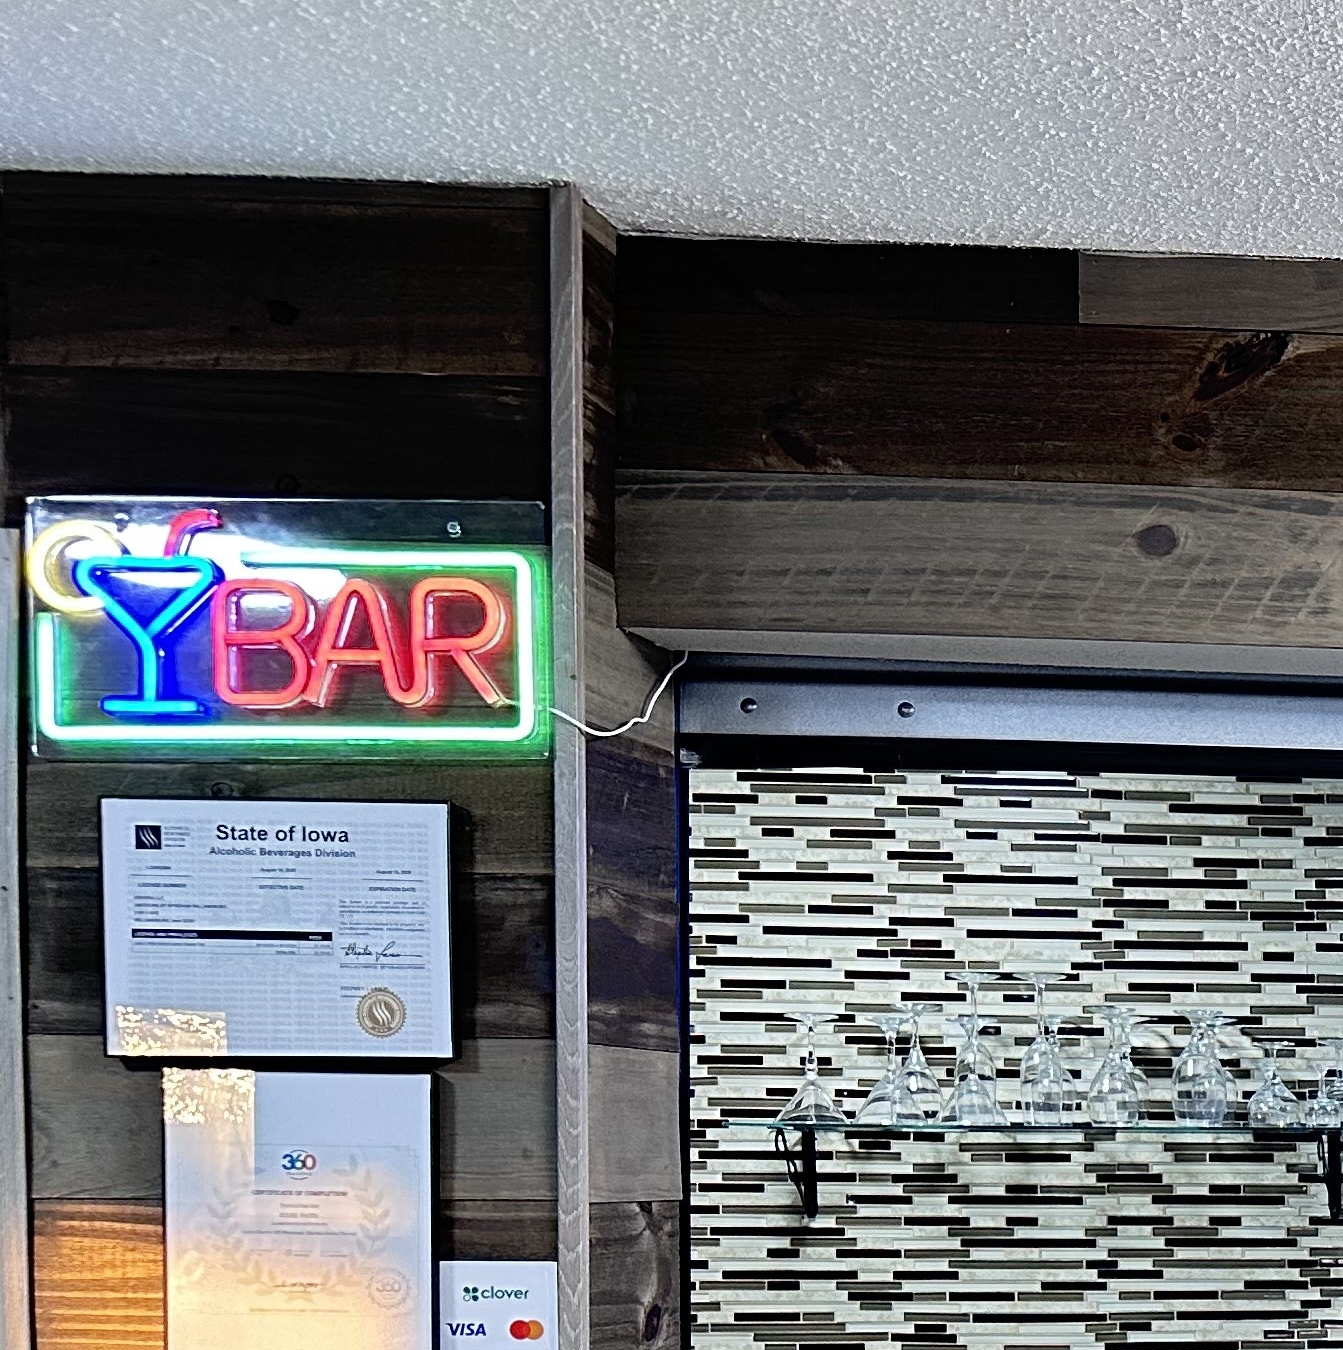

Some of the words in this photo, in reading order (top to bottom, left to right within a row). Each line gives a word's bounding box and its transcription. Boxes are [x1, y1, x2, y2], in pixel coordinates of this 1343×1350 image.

[212, 577, 506, 707] BAR
[216, 824, 268, 841] State
[275, 825, 296, 841] of
[302, 826, 350, 842] Iowa
[209, 846, 257, 856] Alcoholic
[259, 847, 312, 859] Beverages
[315, 849, 356, 858] Division
[281, 1153, 317, 1171] 360
[481, 1285, 529, 1299] clover
[445, 1323, 487, 1336] VISA
